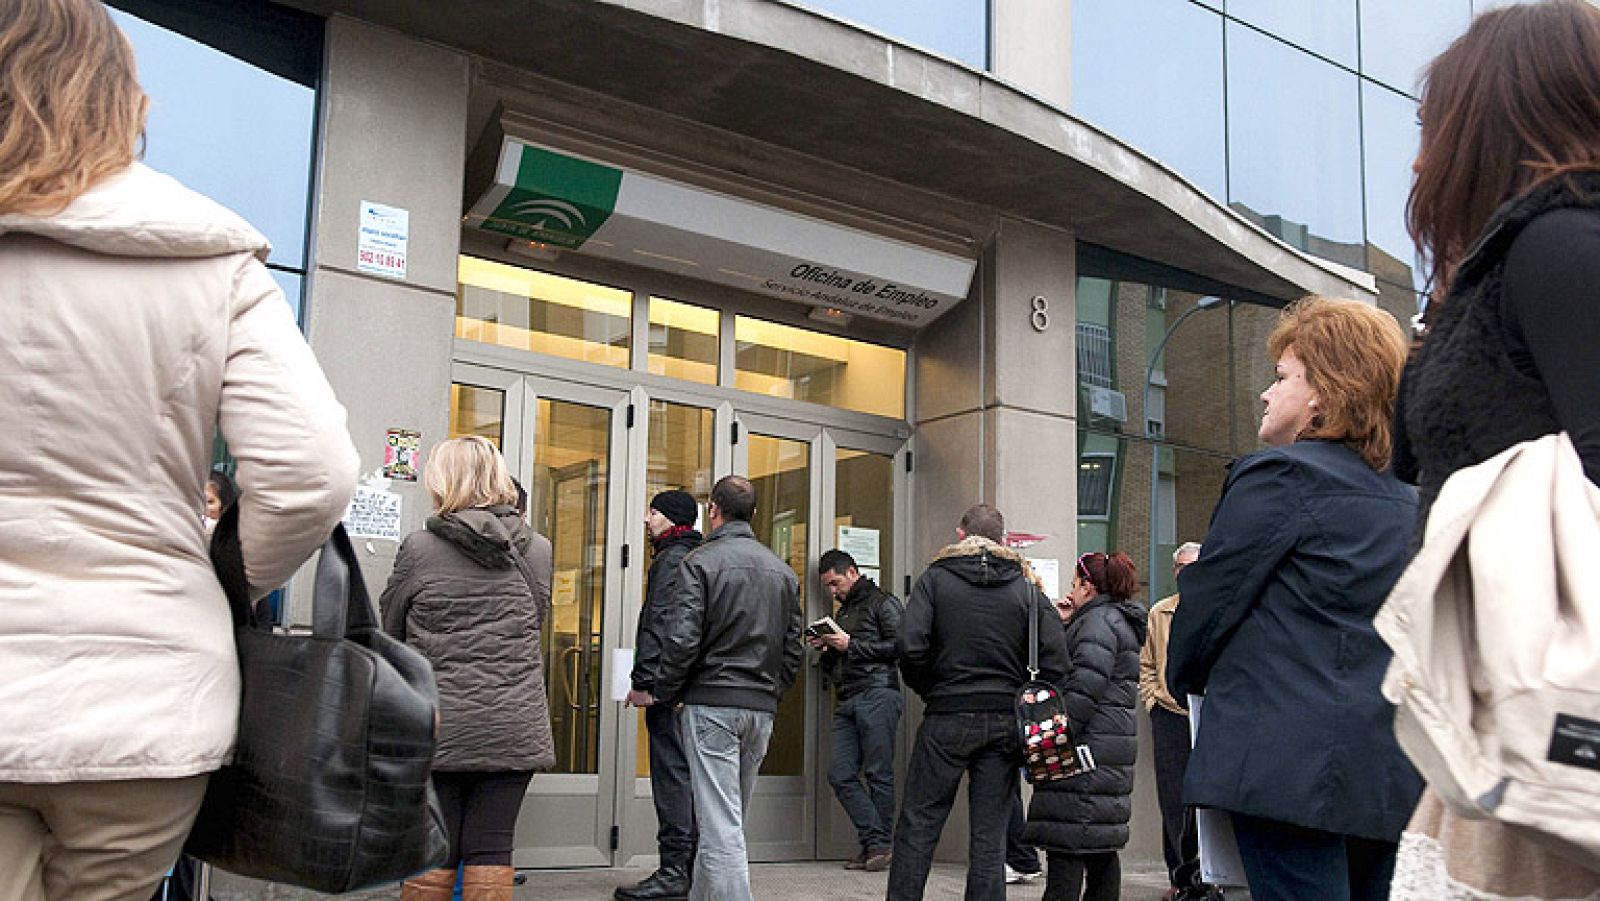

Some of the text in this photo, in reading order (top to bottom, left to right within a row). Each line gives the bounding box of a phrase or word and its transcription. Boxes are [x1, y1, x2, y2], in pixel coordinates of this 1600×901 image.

[791, 263, 938, 310] Oficina de Empleo
[1030, 295, 1049, 332] 8
